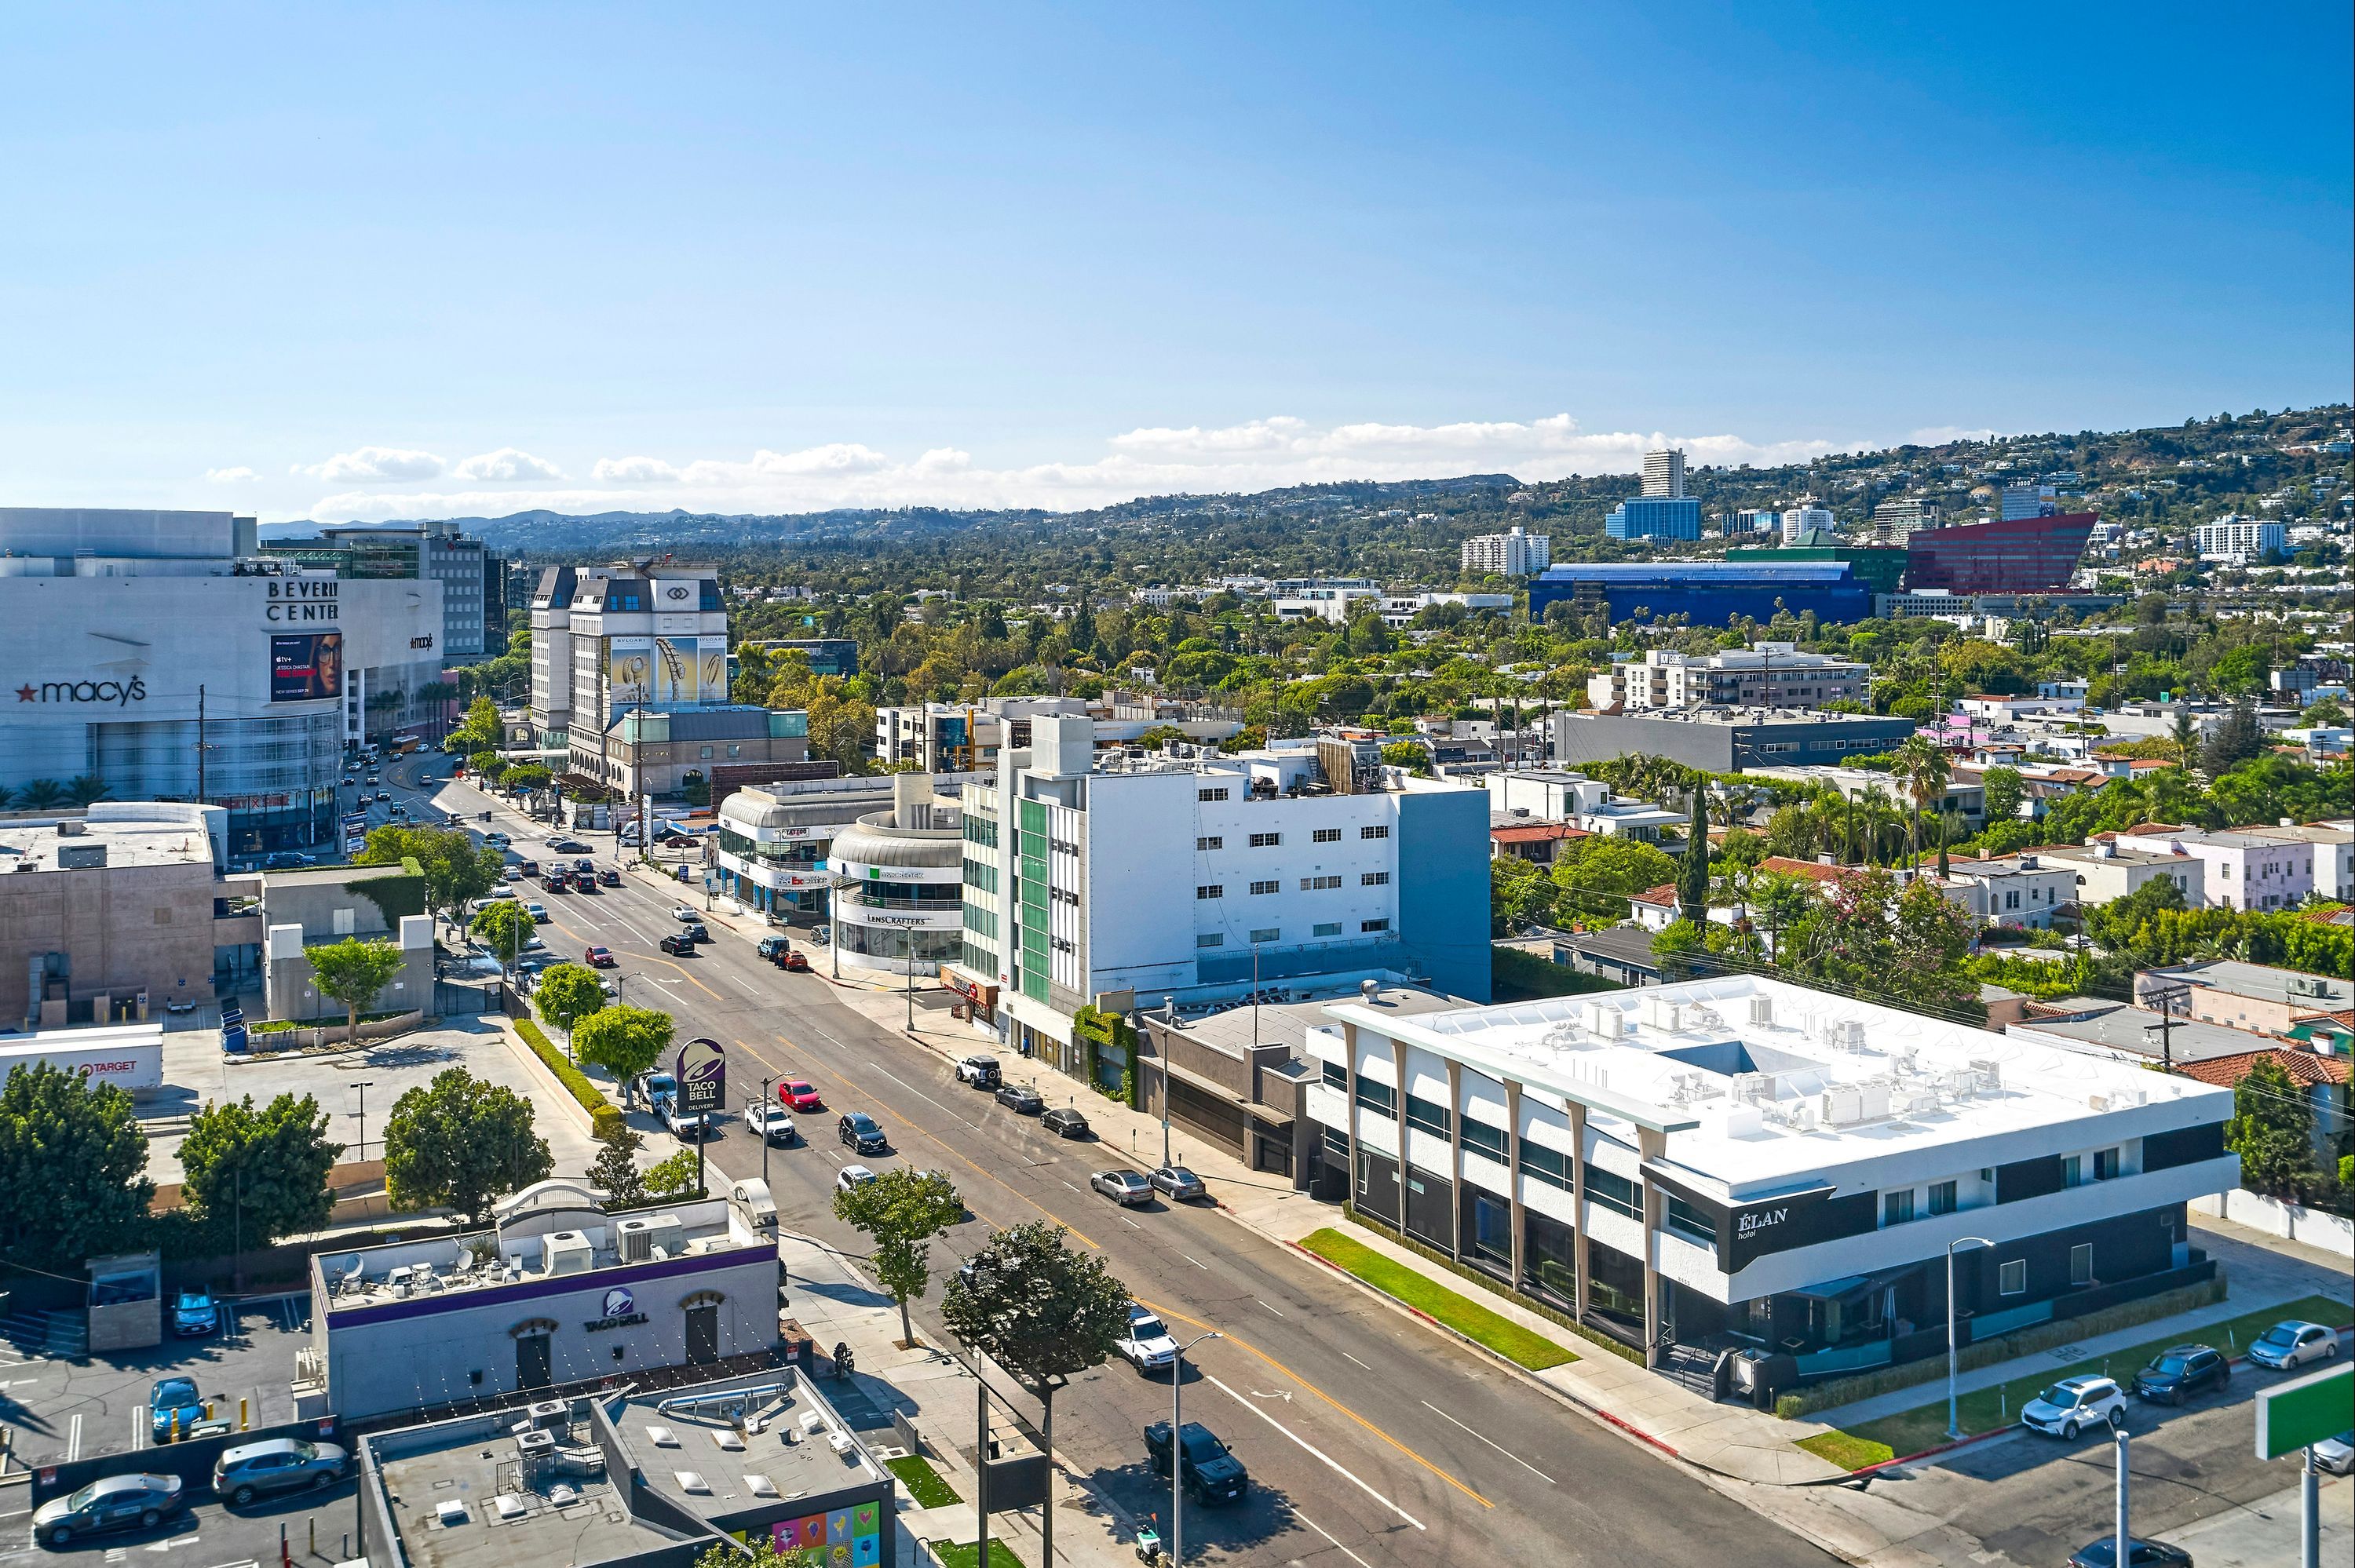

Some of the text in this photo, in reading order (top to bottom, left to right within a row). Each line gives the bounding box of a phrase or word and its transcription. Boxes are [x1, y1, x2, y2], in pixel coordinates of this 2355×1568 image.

[268, 582, 338, 597] BEVERLY
[267, 604, 338, 621] CENTER
[42, 674, 146, 707] macy's
[93, 1060, 137, 1072] TARGET
[686, 1081, 716, 1092] TACO
[689, 1090, 716, 1101] BELL
[688, 1103, 714, 1111] DELIVERY
[1738, 1208, 1788, 1232] ÉLAN
[1737, 1229, 1757, 1240] hotel
[583, 1318, 618, 1333] TACO
